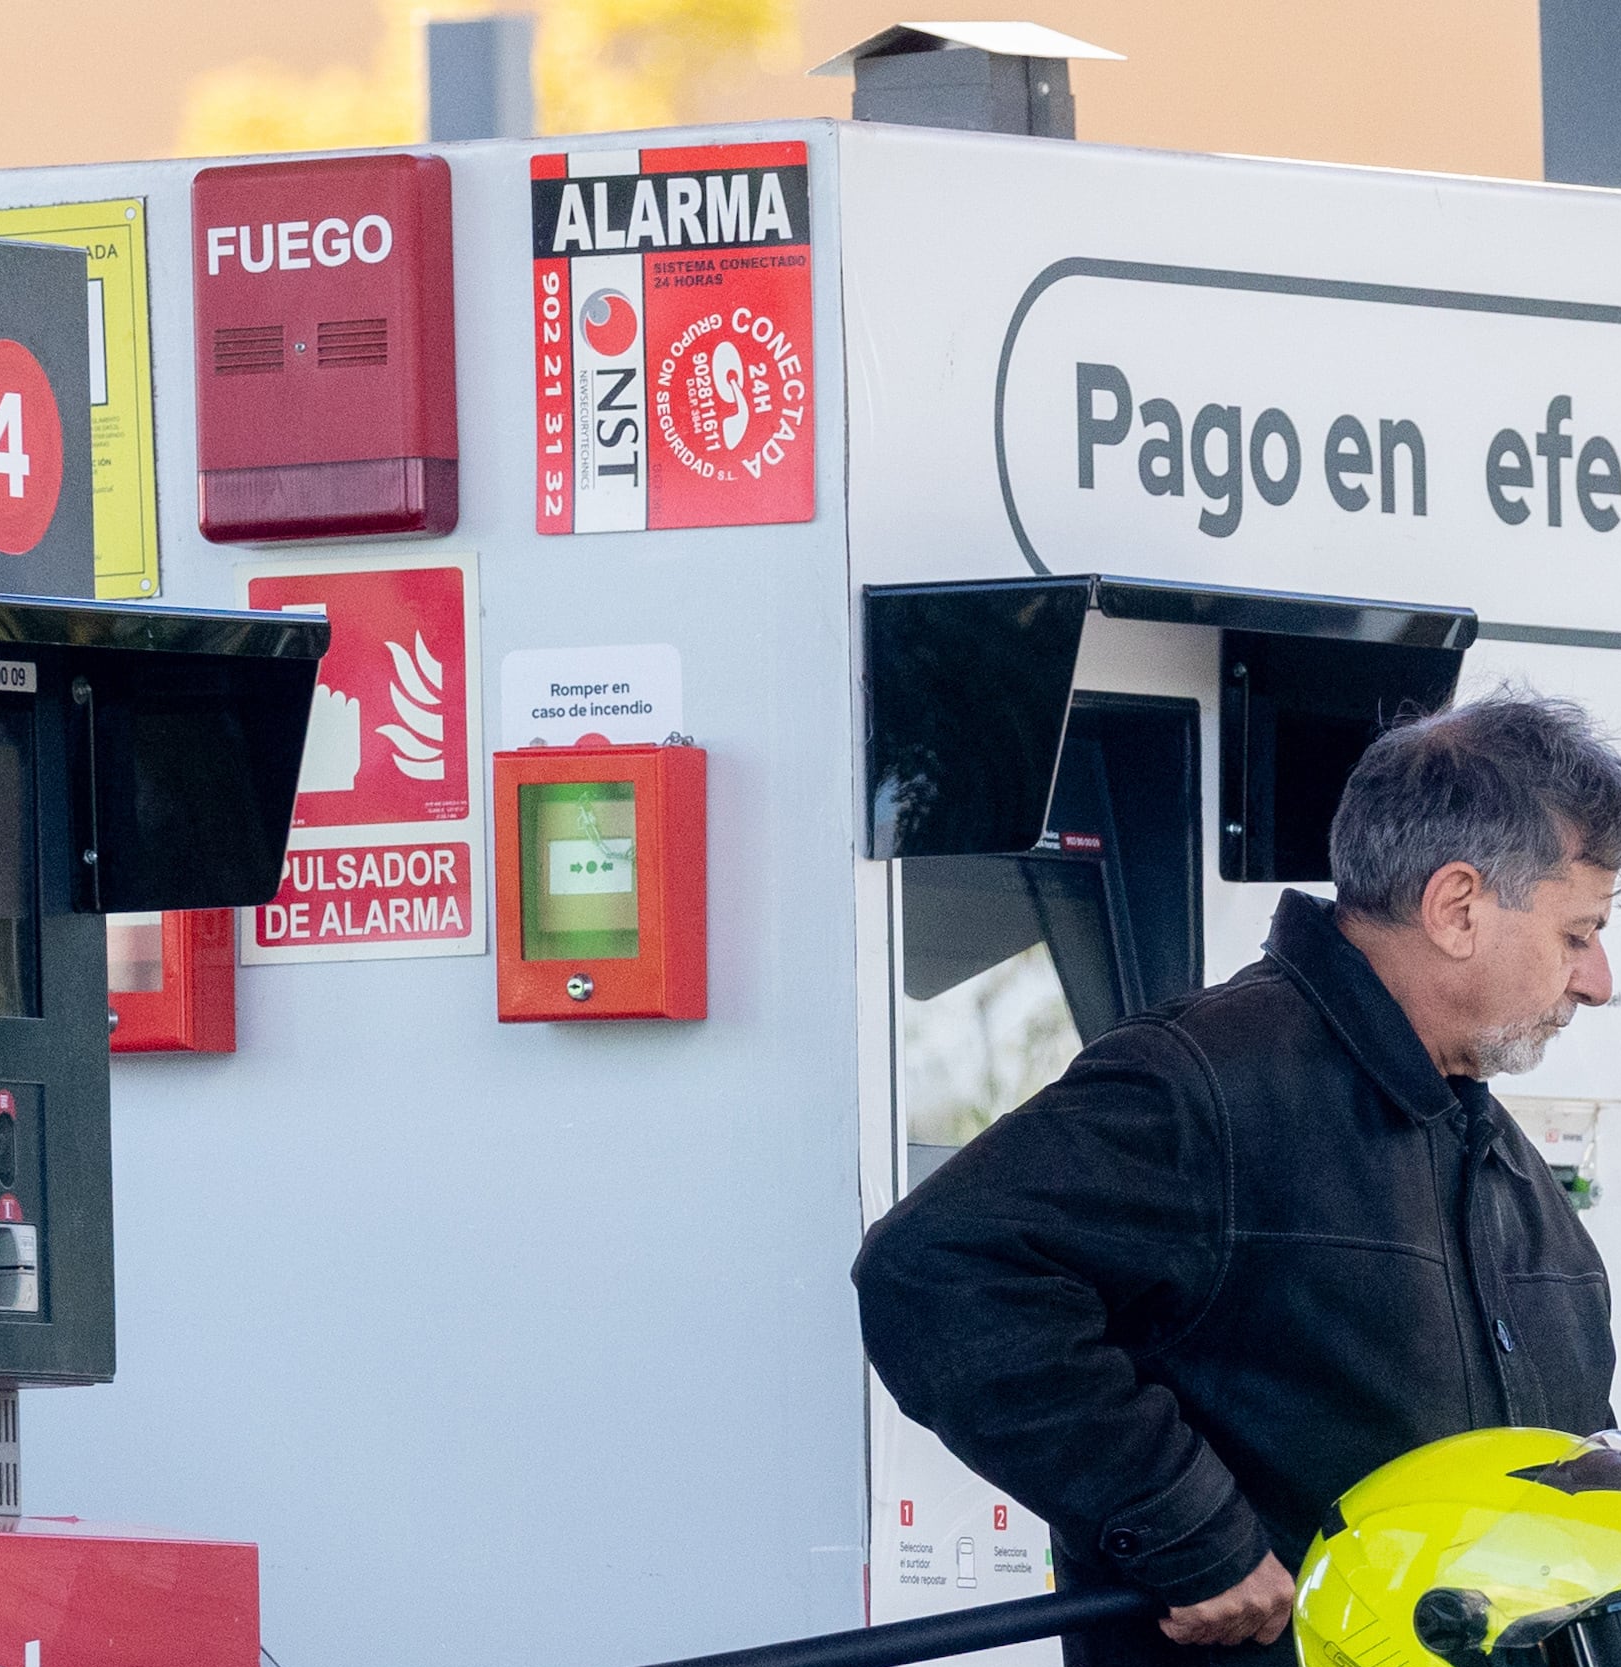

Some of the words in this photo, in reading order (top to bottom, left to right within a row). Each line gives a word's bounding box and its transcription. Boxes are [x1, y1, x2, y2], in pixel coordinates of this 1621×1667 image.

[552, 170, 793, 253] ALARMA
[205, 213, 394, 276] FUEGO
[653, 259, 716, 275] SISTEMA
[720, 255, 807, 271] CONECTADO
[653, 276, 671, 288] 24
[673, 273, 724, 288] HORAS
[541, 271, 562, 345] 902
[670, 313, 723, 358] GRUPO
[543, 355, 563, 398] 21
[657, 358, 676, 387] ON
[747, 361, 773, 414] 24H
[731, 306, 806, 480] CONECTADA
[544, 412, 564, 455] 31
[595, 366, 640, 488] NST
[656, 390, 716, 479] SEGURIDAD
[1074, 360, 1304, 538] Pago
[1323, 412, 1429, 517] en
[544, 470, 564, 518] 32
[10, 667, 27, 687] 09
[550, 683, 610, 698] Romper
[611, 682, 631, 694] en
[531, 706, 566, 719] caso
[568, 703, 588, 718] de
[589, 700, 654, 717] incendio
[264, 902, 311, 940] DE
[318, 895, 465, 938] ALARMA
[903, 1504, 910, 1523] 1
[996, 1509, 1005, 1527] 2
[899, 1541, 934, 1554] Selecciona
[900, 1558, 906, 1568] el
[906, 1558, 931, 1569] surtidor
[993, 1546, 1028, 1558] Selecciona
[899, 1575, 920, 1585] donde
[920, 1575, 948, 1586] repostar
[993, 1563, 1033, 1574] combustible
